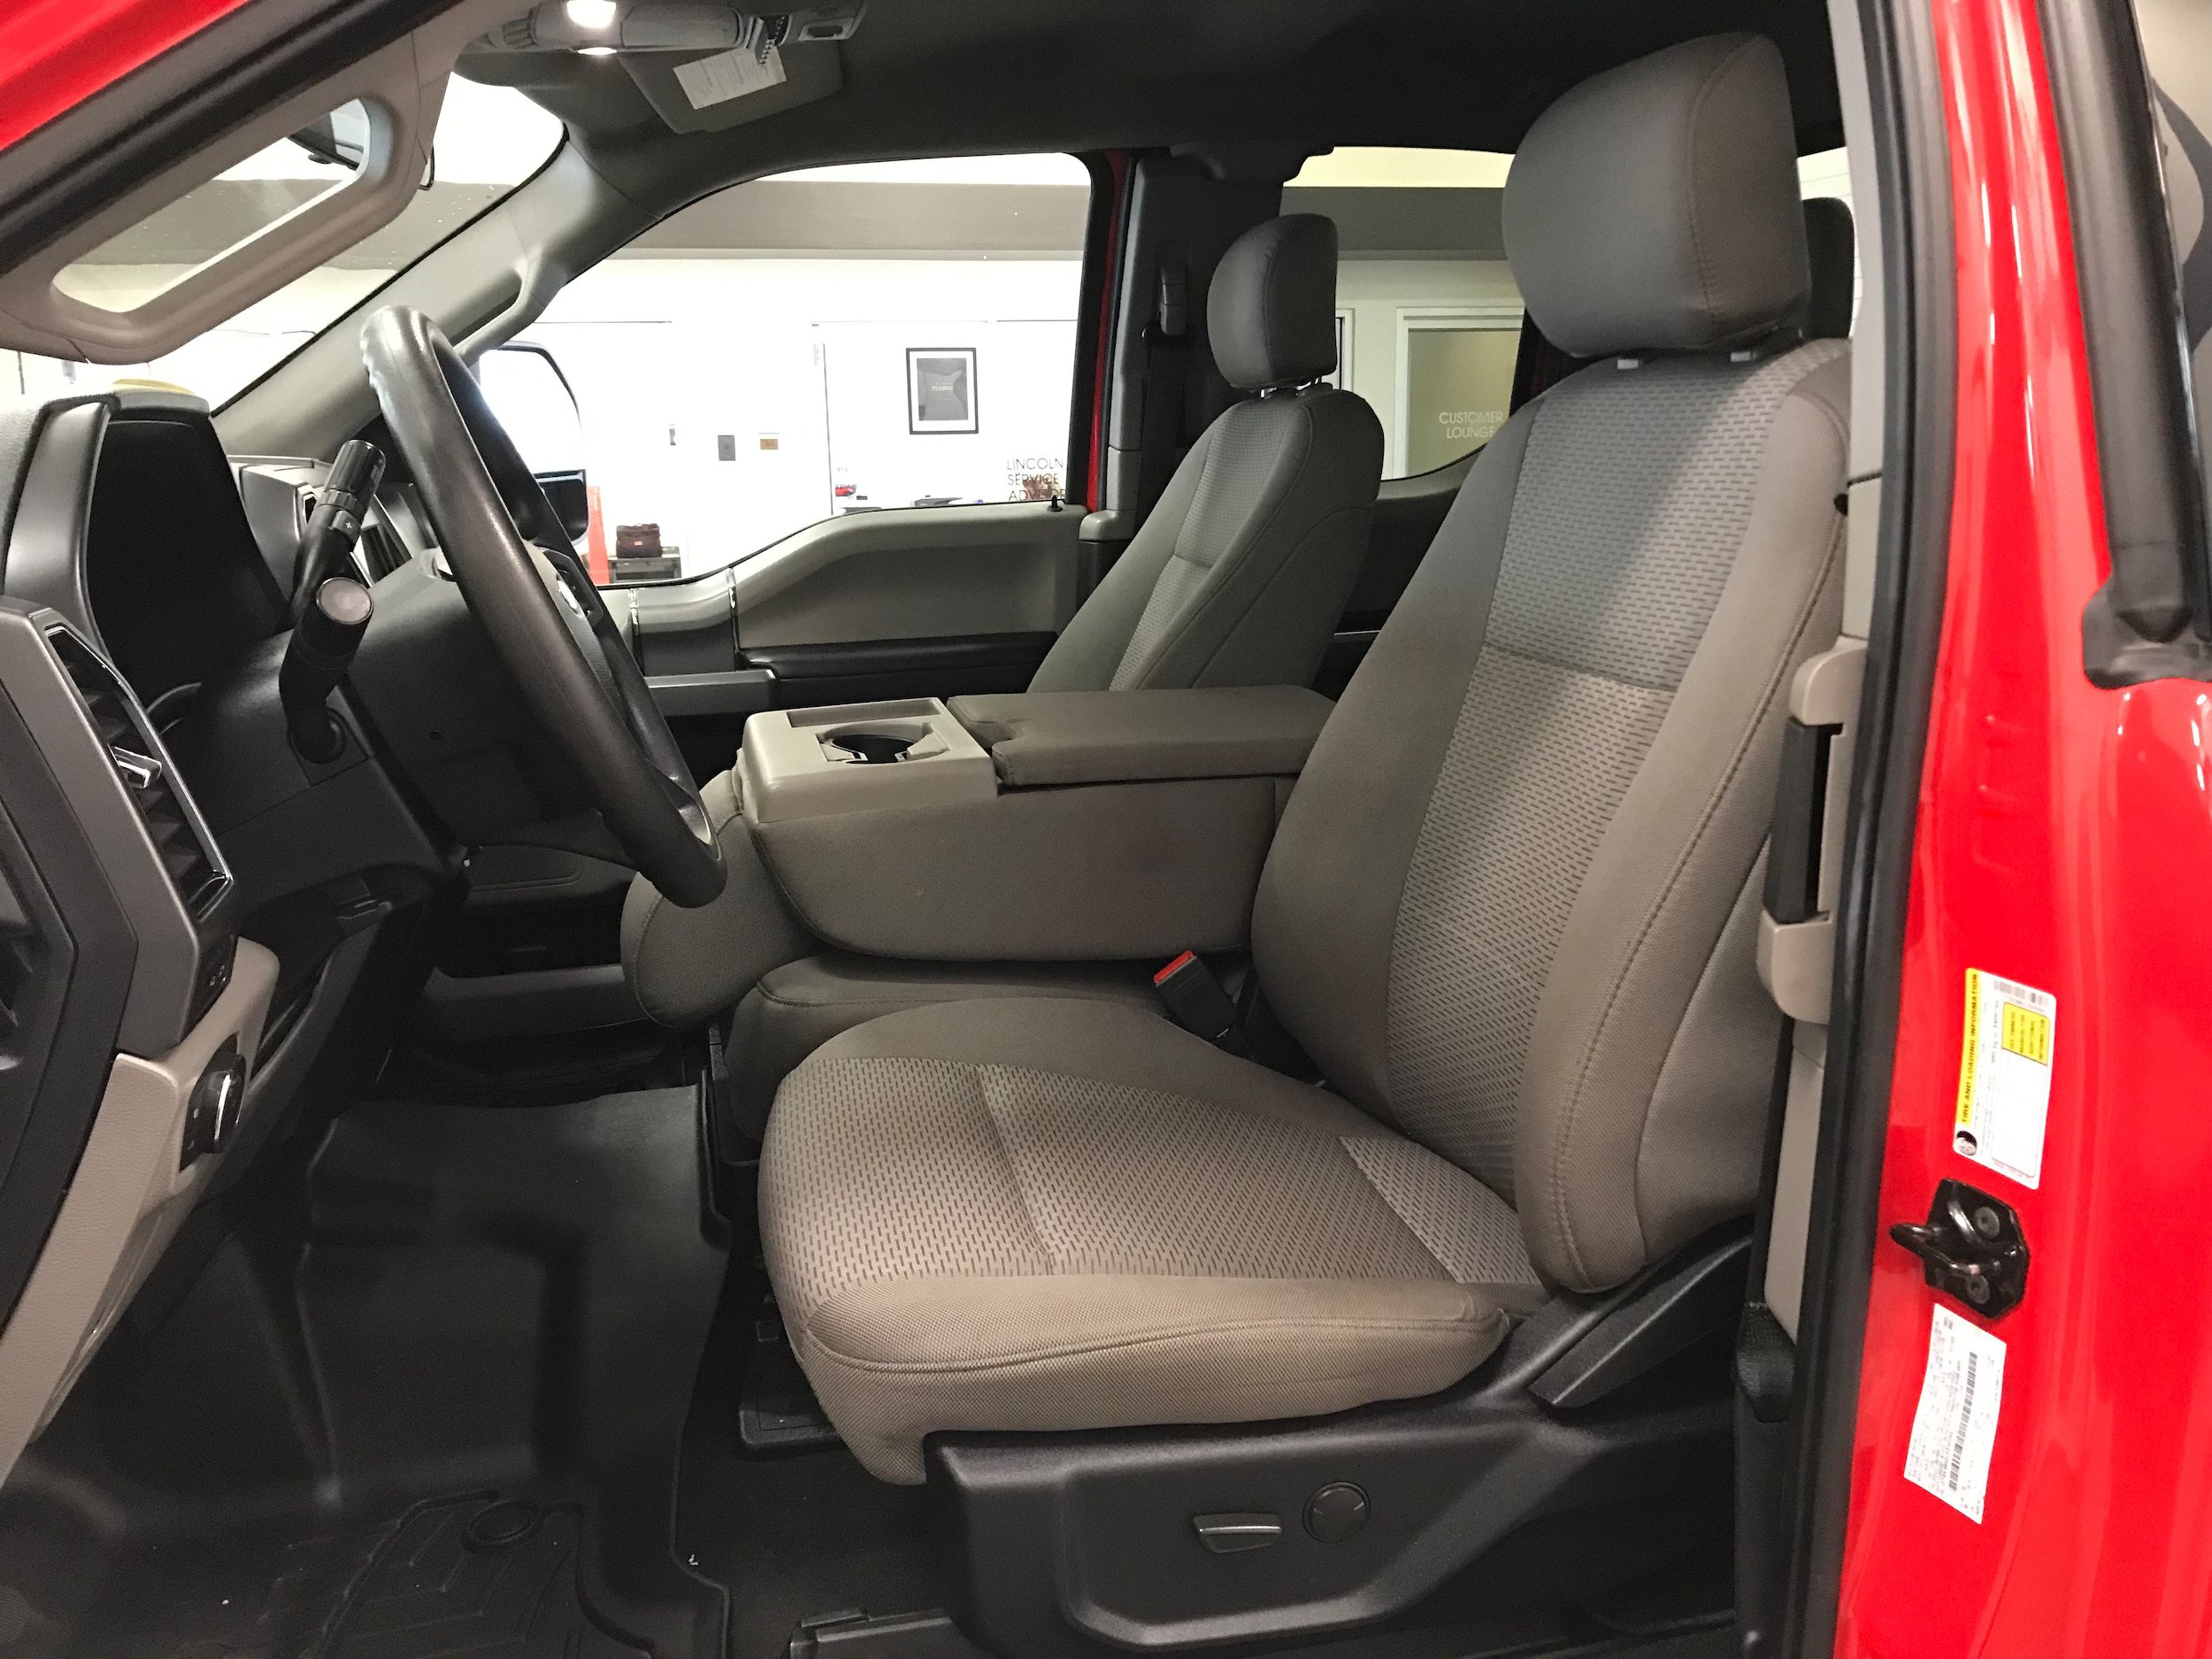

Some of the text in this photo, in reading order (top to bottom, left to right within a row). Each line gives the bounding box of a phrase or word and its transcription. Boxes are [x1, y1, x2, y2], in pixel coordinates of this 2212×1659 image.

[1439, 411, 1503, 425] CUSTOMER
[1446, 426, 1495, 439] LOUNGE
[1006, 457, 1064, 471] LINCOLN
[1007, 472, 1059, 485] SERVICE
[1967, 1041, 1976, 1080] LOADING
